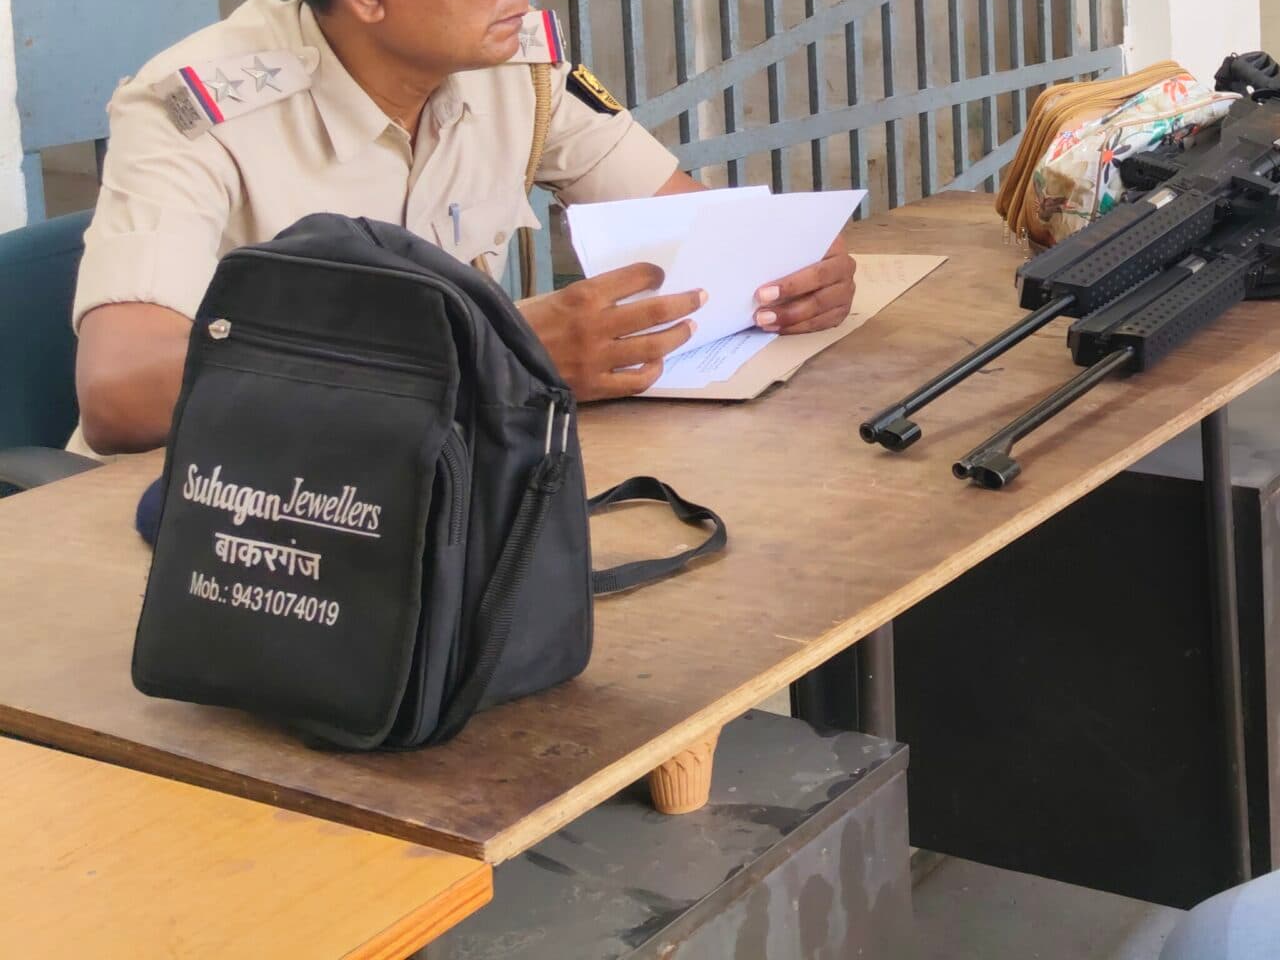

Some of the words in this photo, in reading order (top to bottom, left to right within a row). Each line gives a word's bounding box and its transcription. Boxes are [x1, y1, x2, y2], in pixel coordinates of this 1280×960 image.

[183, 463, 281, 526] Suhagan
[282, 477, 382, 531] Jewellers
[214, 531, 322, 581] बाकरगंज
[188, 570, 229, 604] Mob.:
[230, 582, 340, 626] 9431074019
